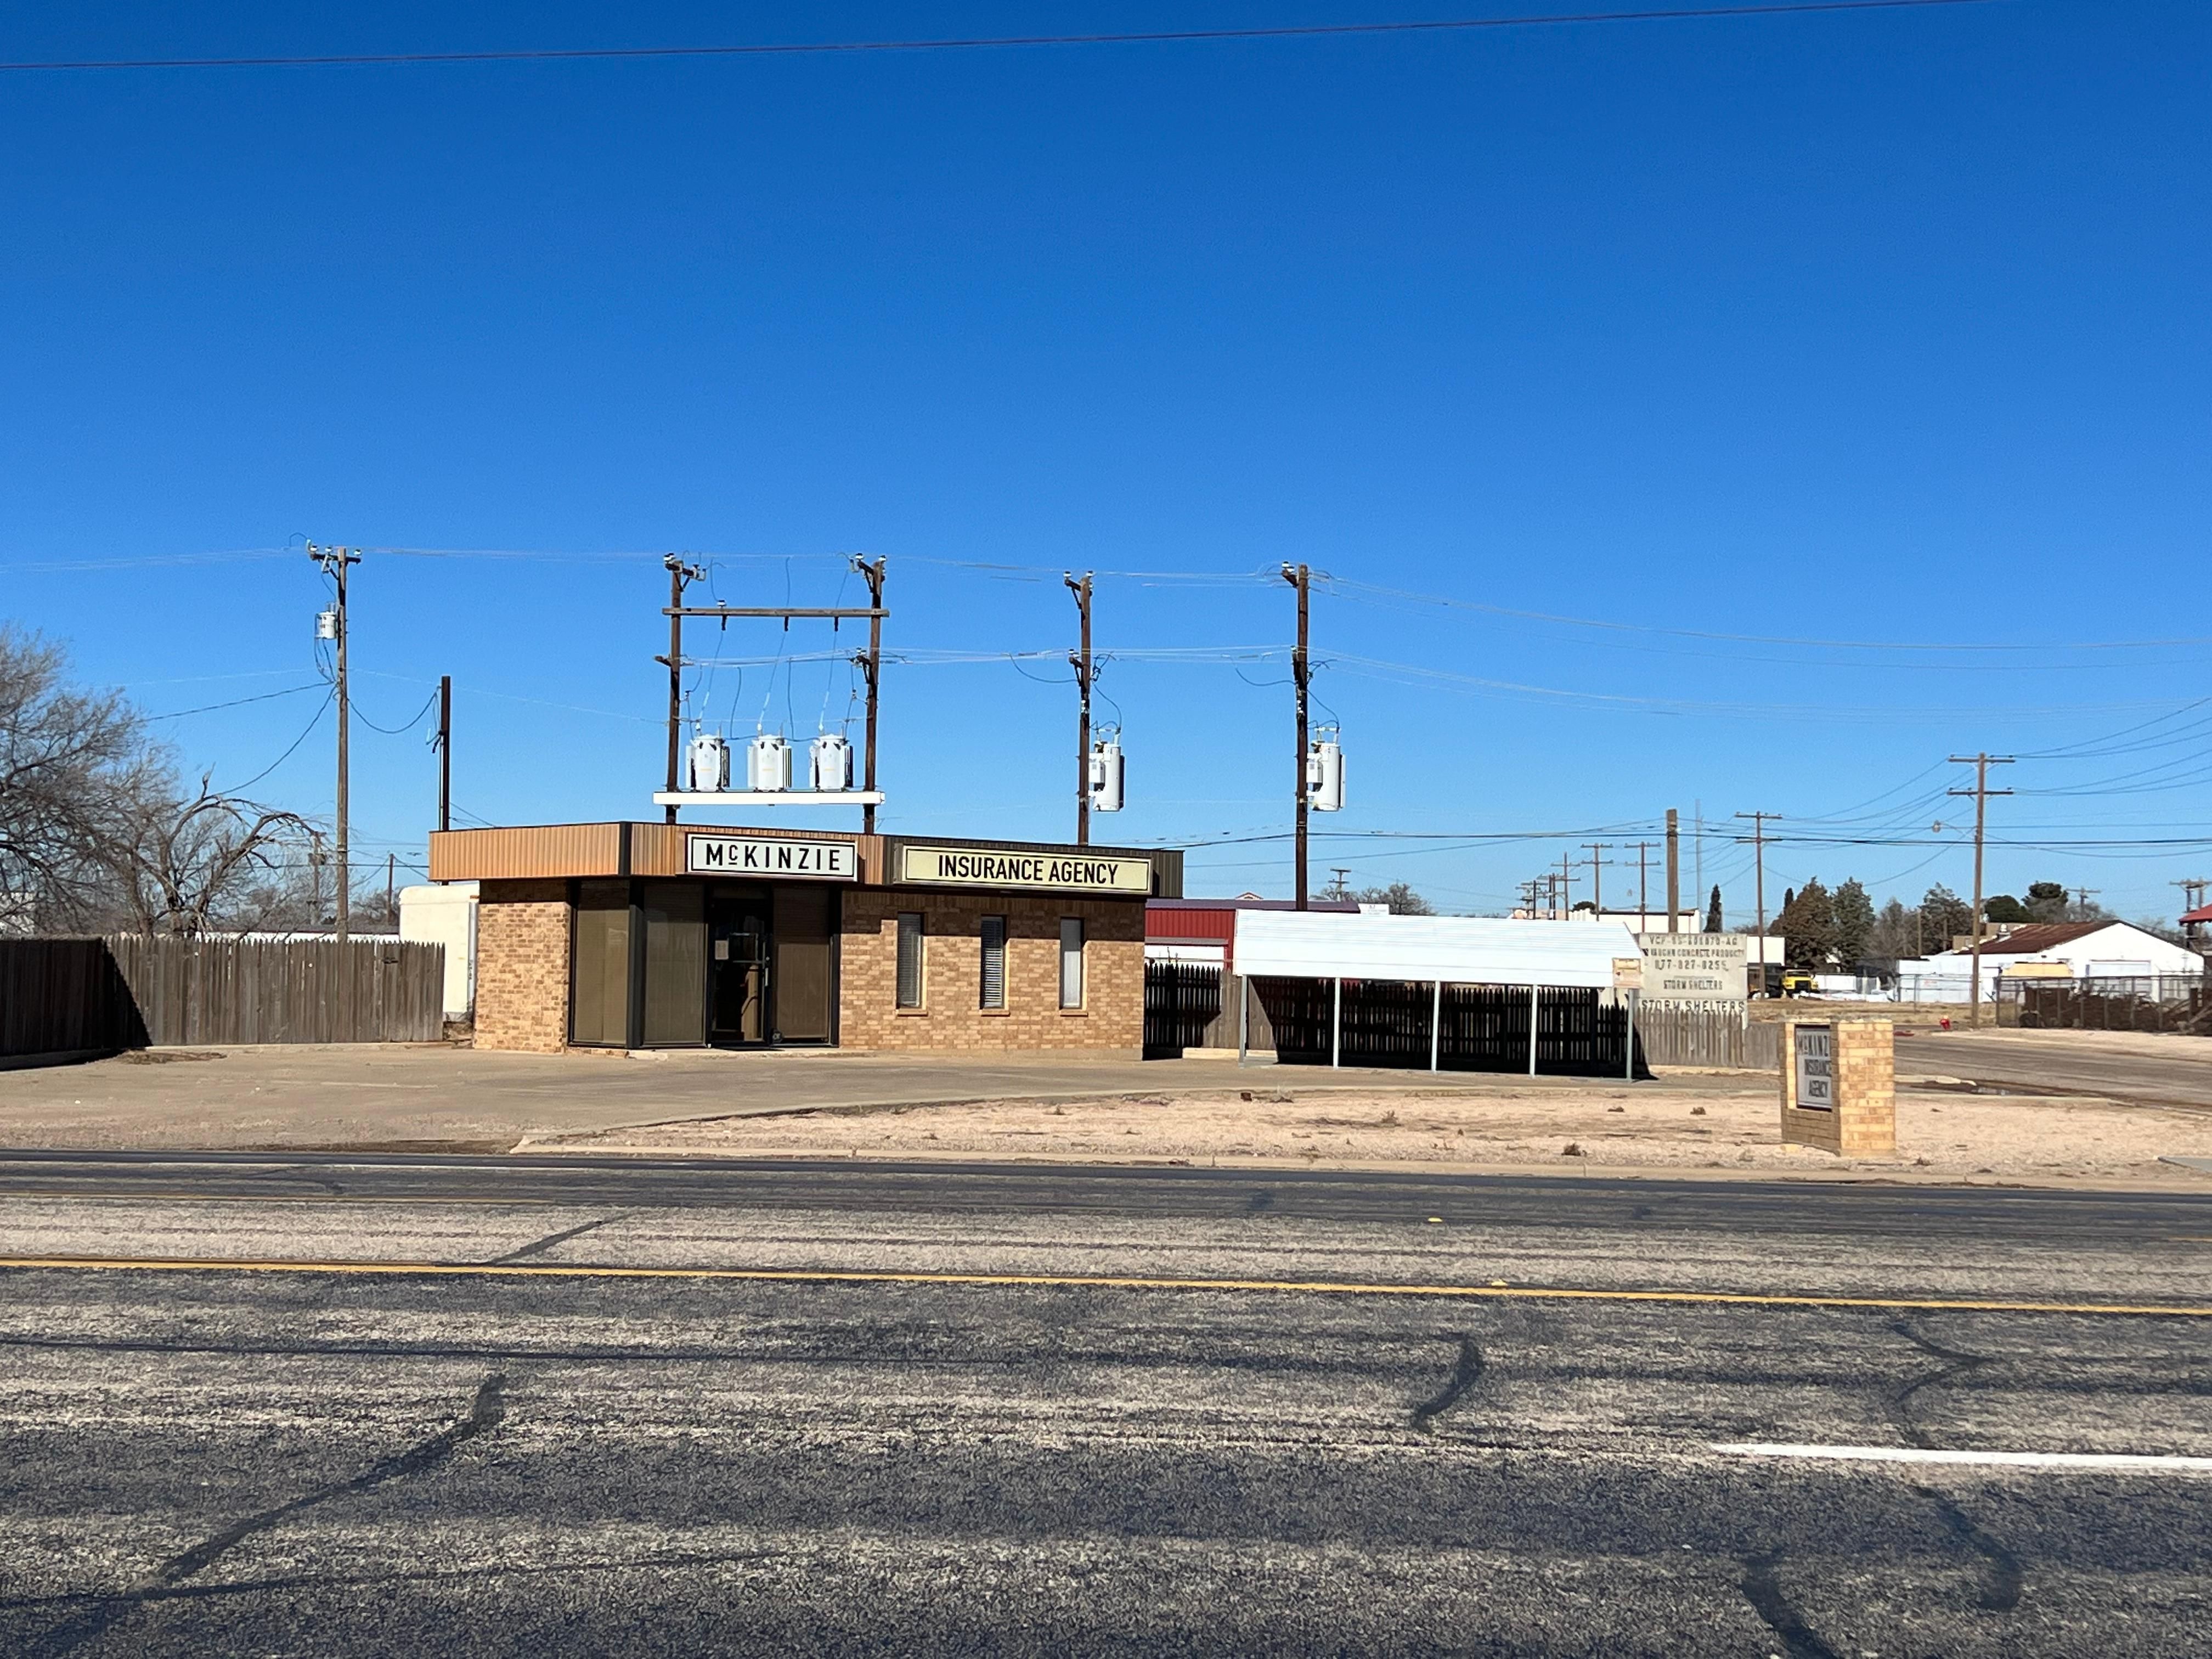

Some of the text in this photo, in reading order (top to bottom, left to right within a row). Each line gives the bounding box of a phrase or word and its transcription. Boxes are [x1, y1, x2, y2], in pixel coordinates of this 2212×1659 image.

[938, 855, 1119, 884] INSURANCE AGENCY
[1663, 979, 1723, 990] STORM SHELTERS
[1685, 1000, 1745, 1013] SHELTERS
